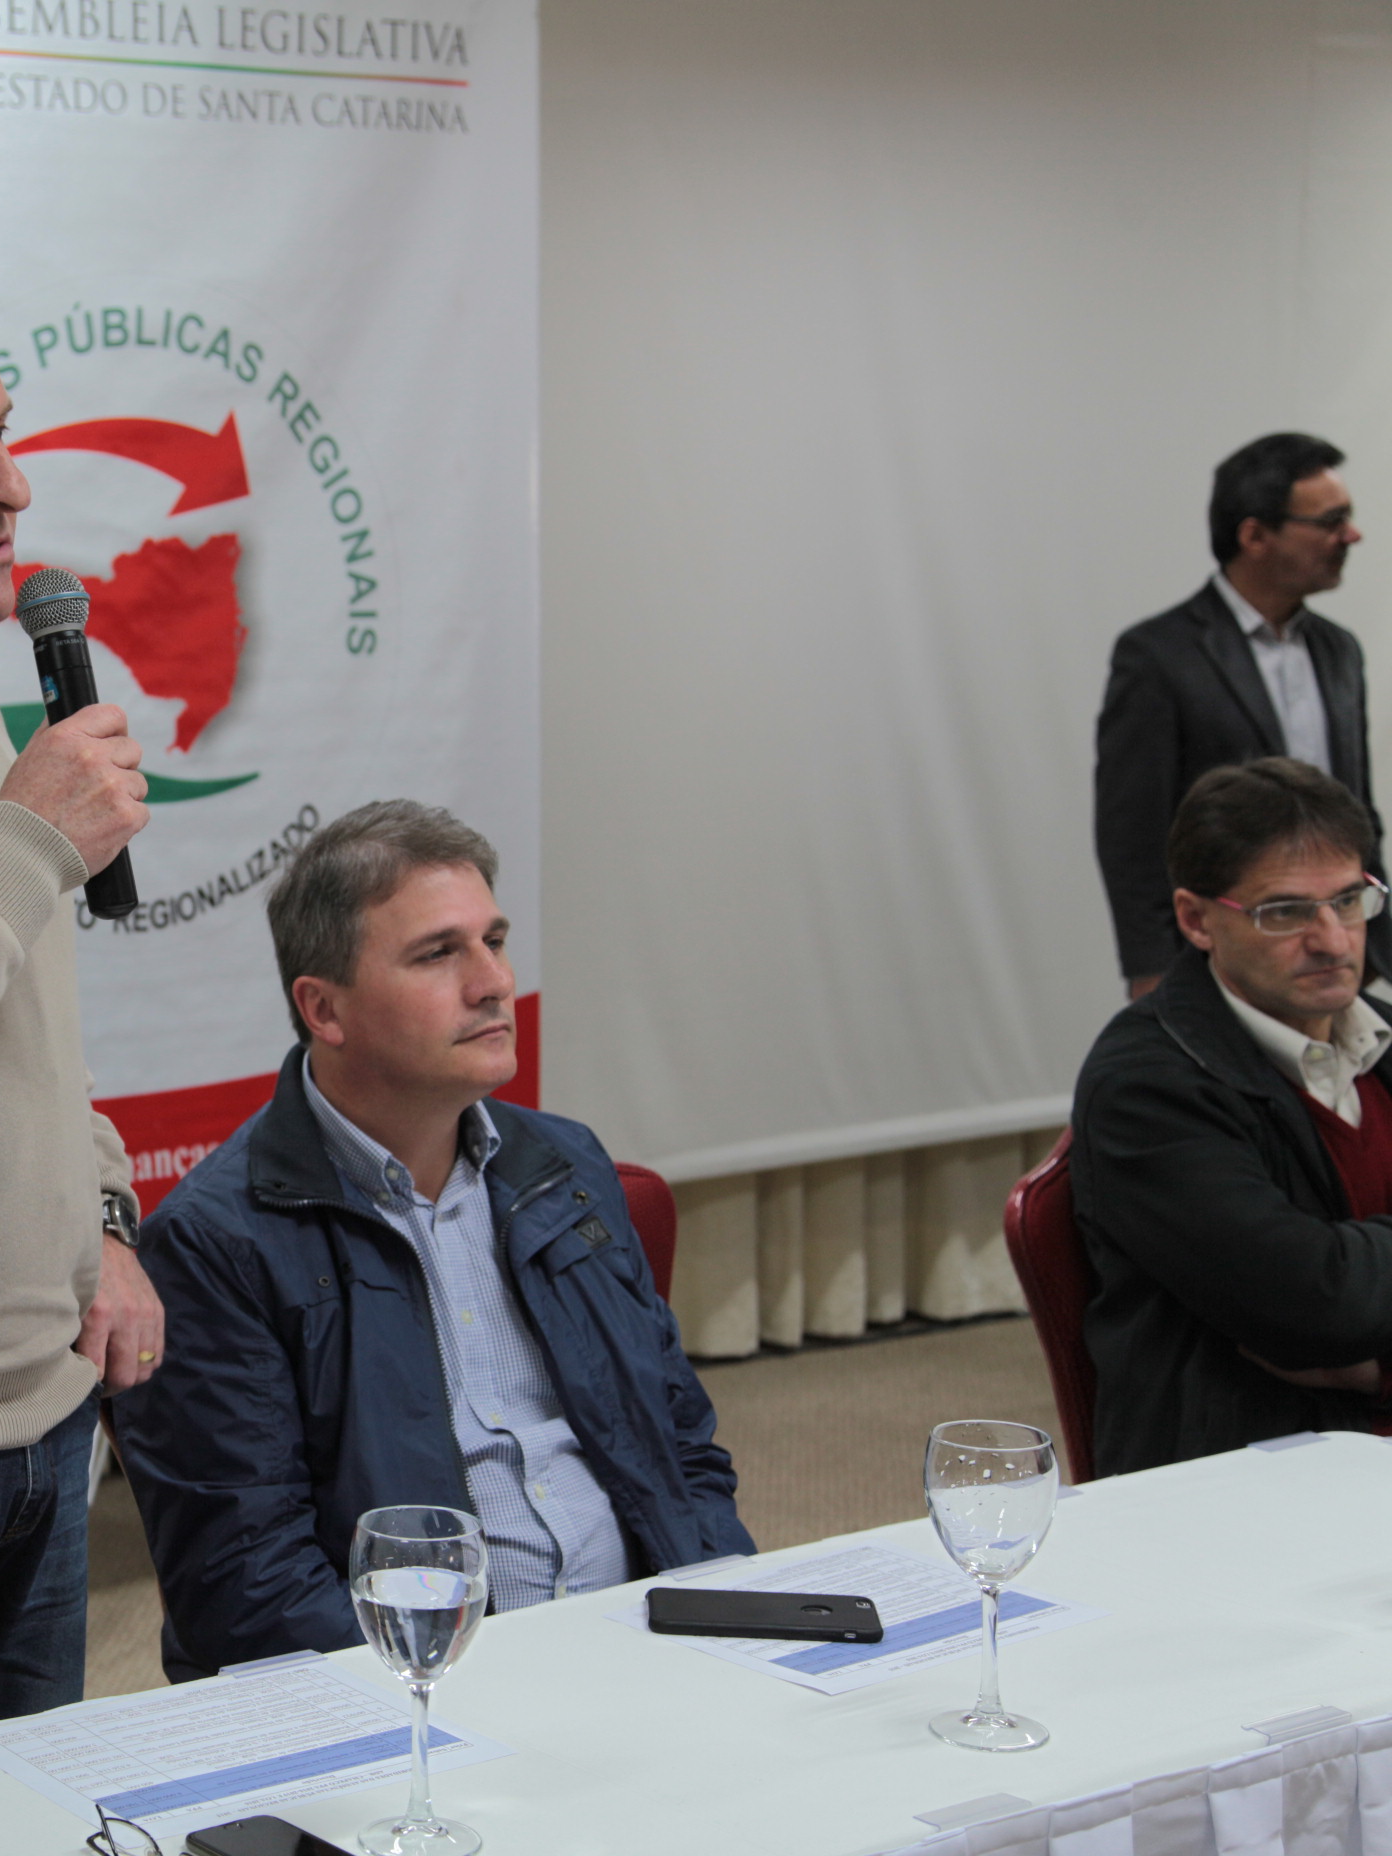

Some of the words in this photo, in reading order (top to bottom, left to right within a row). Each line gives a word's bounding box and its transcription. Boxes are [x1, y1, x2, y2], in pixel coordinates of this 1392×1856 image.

[217, 5, 469, 66] LEGISLATIVA
[142, 81, 188, 118] DE
[198, 84, 302, 126] SANTA
[311, 92, 470, 133] CATARINA
[32, 302, 264, 384] PÚBLICAS
[267, 371, 379, 656] REGIONAIS
[112, 803, 319, 935] REGIONALIZADO
